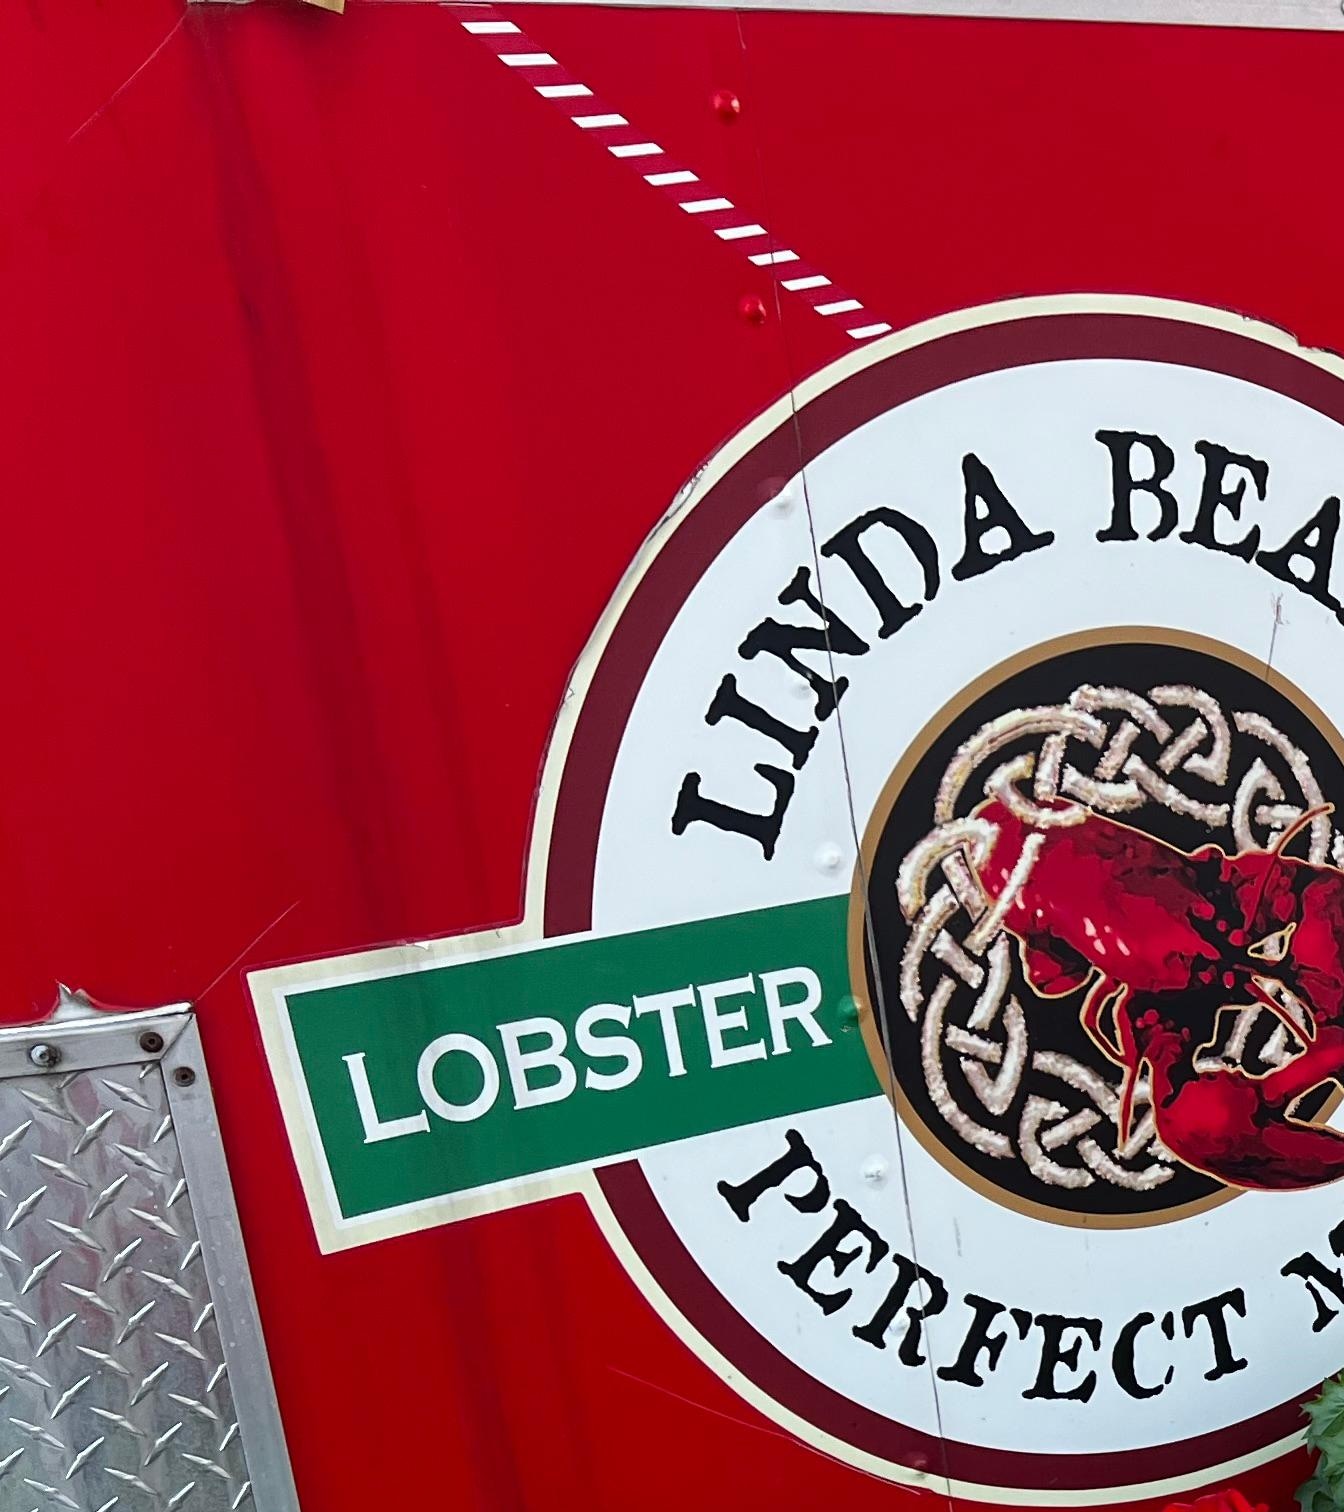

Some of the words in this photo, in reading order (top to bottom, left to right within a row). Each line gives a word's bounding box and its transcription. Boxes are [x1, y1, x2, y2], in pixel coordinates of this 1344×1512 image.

[672, 453, 1054, 861] LINDA
[342, 967, 832, 1143] LOBSTER
[717, 1129, 1247, 1403] PERFECT
